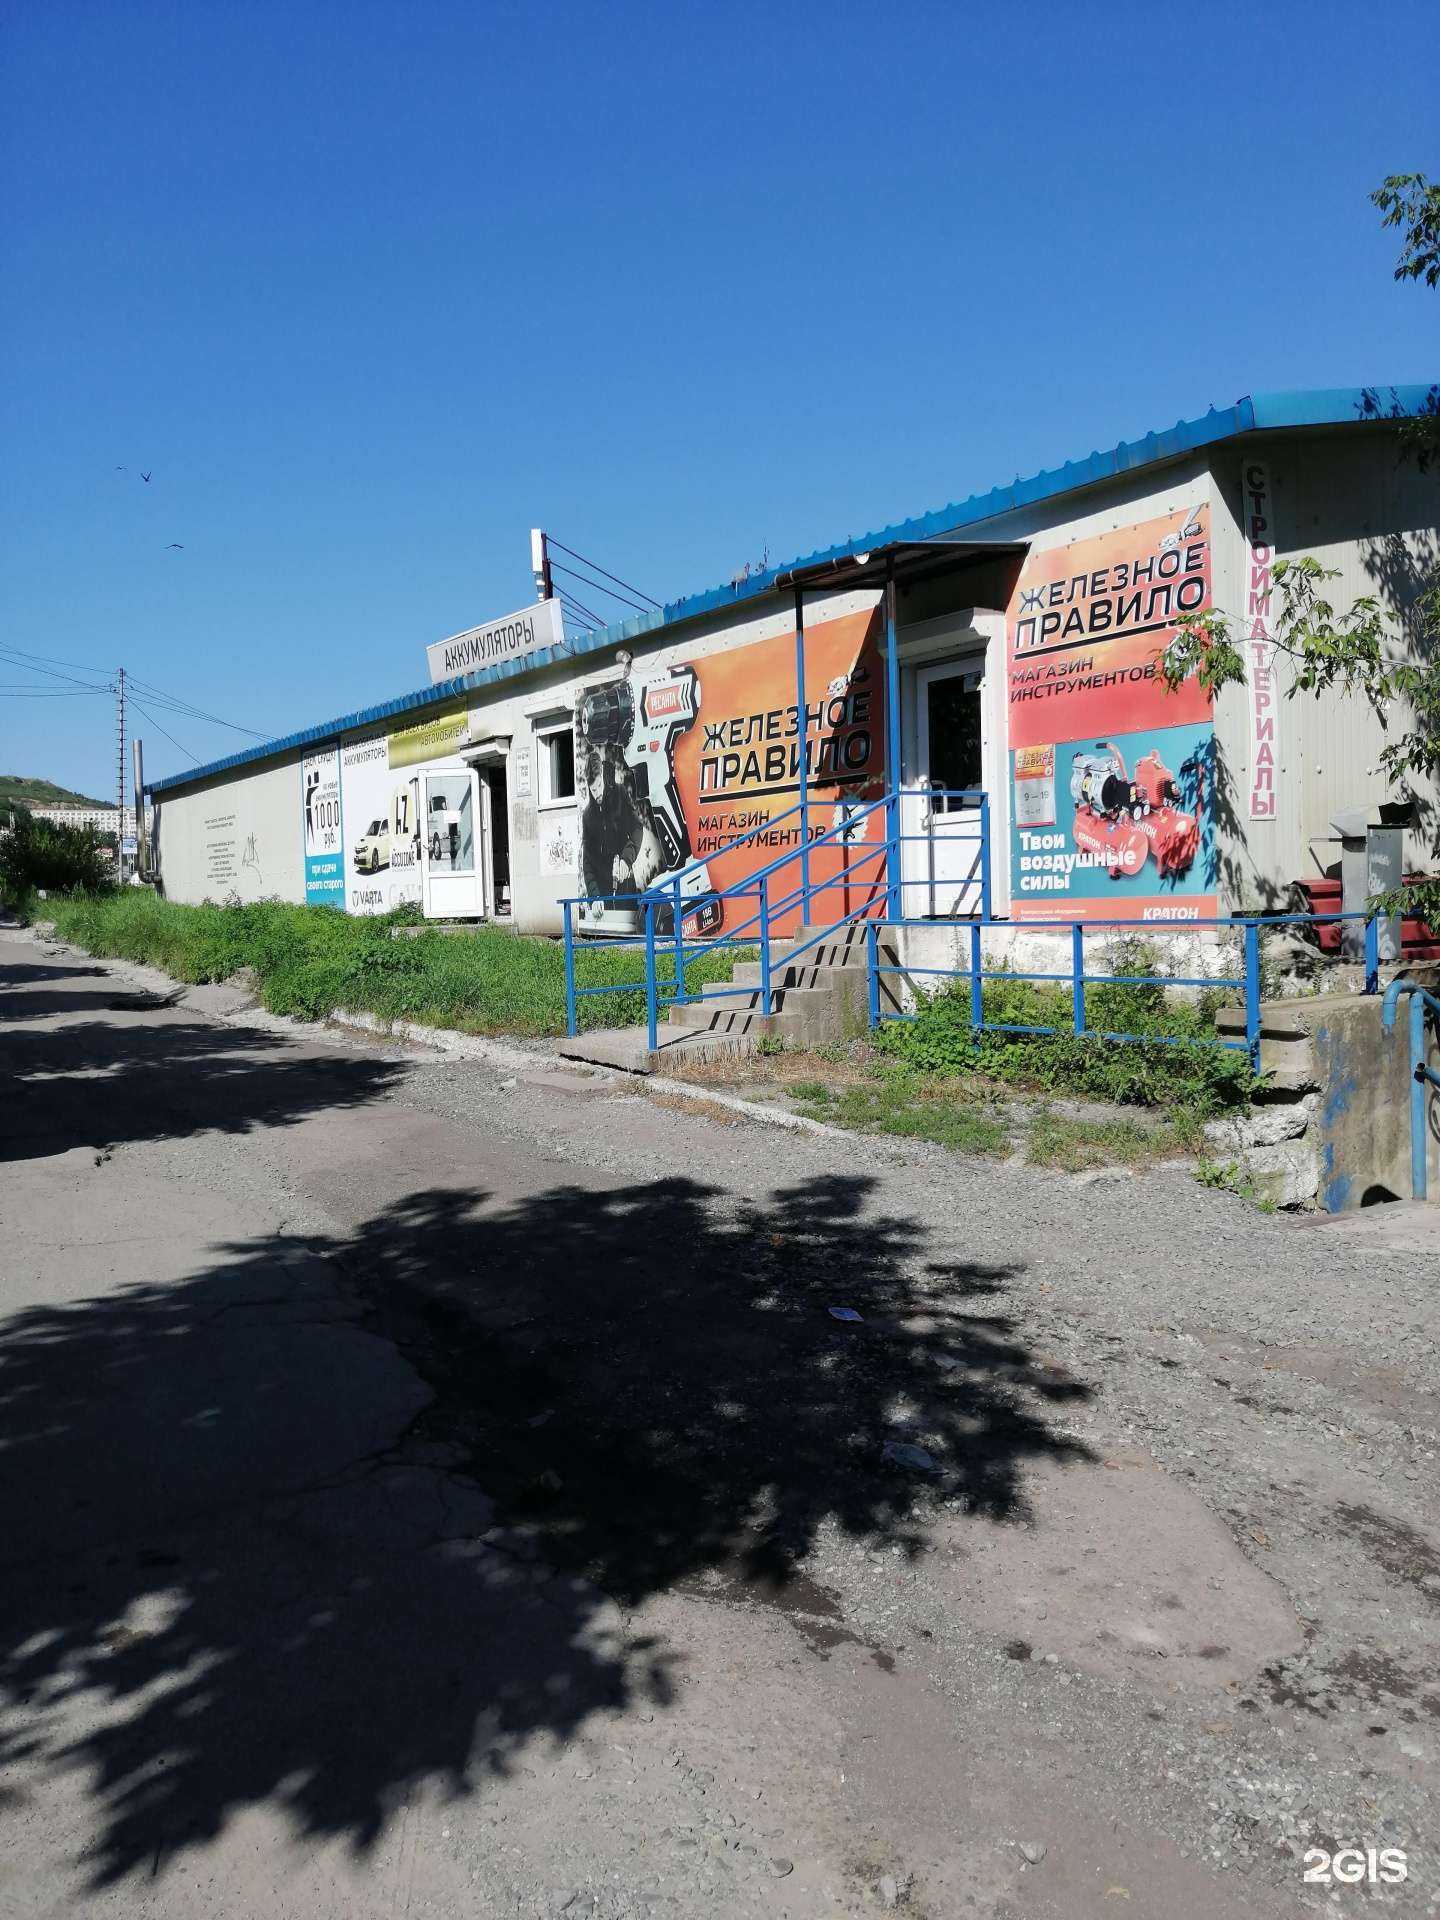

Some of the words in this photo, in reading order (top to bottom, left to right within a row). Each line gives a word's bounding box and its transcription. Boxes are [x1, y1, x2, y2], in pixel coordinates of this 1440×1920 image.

[1018, 541, 1207, 614] ЖЕЛЕЗНОЕ
[1015, 575, 1206, 648] ПРАВИЛО
[444, 616, 535, 673] АККУМУЛЯТОРЫ
[1010, 663, 1157, 703] ИНСТРУМЕНТОВ
[1011, 656, 1094, 685] МАГАЗИН
[702, 690, 873, 752] ЖЕЛЕЗНОЕ
[700, 729, 872, 791] ПРАВИЛО
[315, 800, 340, 829] 1000
[698, 810, 770, 831] МАГАЗИН
[697, 825, 827, 852] ИНСТРУМЕНТОВ
[1020, 831, 1065, 850] Твои
[1020, 849, 1137, 874] воздушные
[1020, 873, 1070, 891] силы
[1143, 907, 1199, 920] КРАТОН
